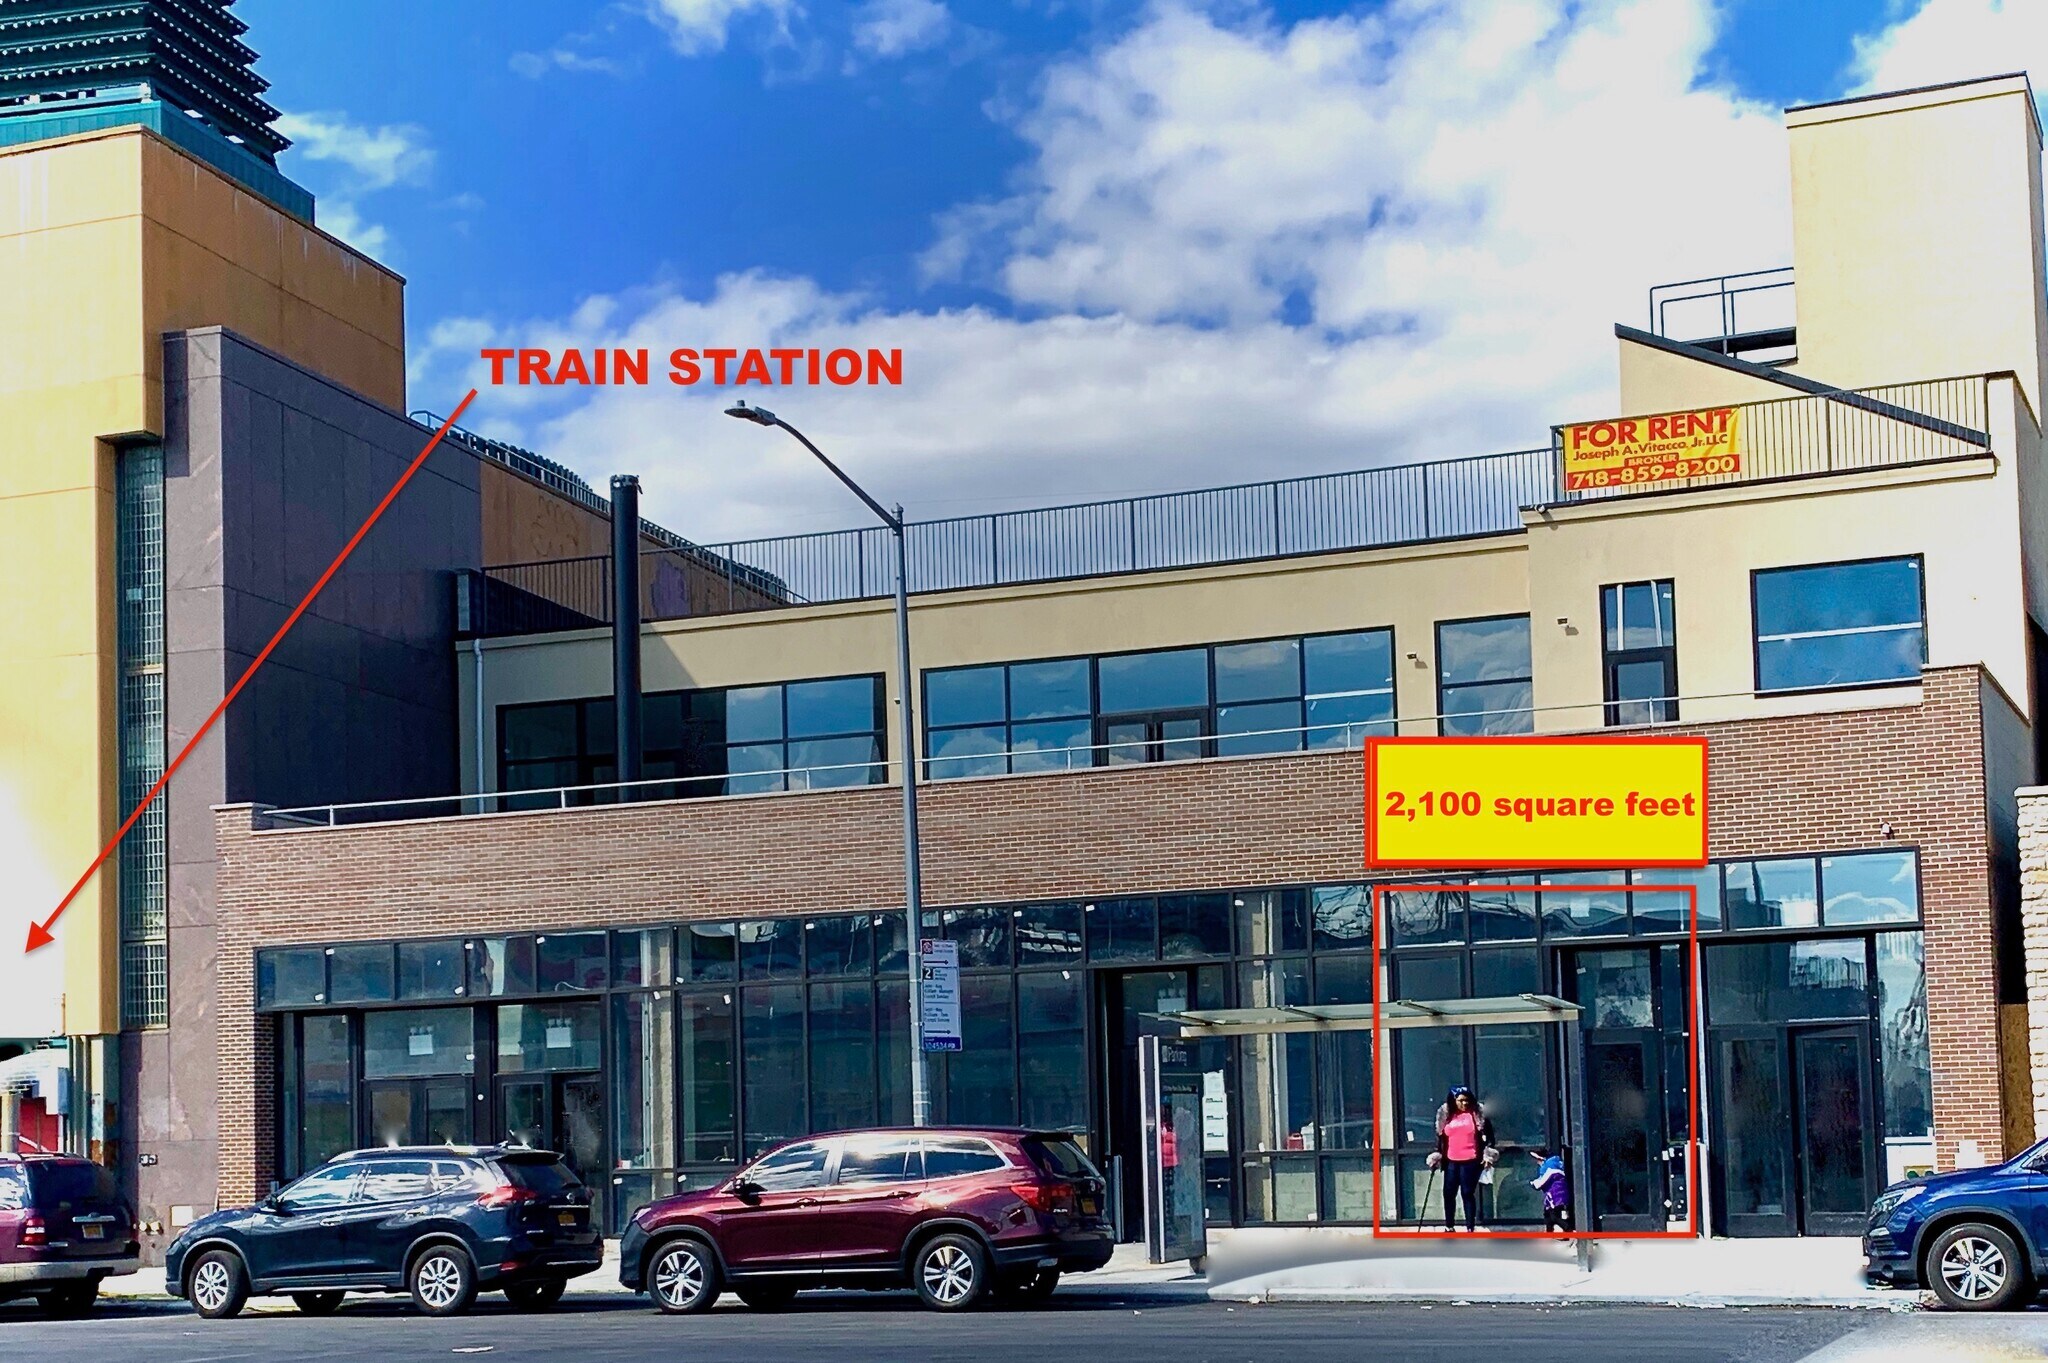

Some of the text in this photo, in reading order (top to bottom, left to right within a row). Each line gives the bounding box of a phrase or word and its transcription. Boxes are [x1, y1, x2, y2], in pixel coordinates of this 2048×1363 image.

[1572, 408, 1732, 450] FOR RENT
[1573, 447, 1620, 461] Joseph
[1628, 454, 1677, 466] BROKER
[1572, 456, 1735, 489] 718-859-8200
